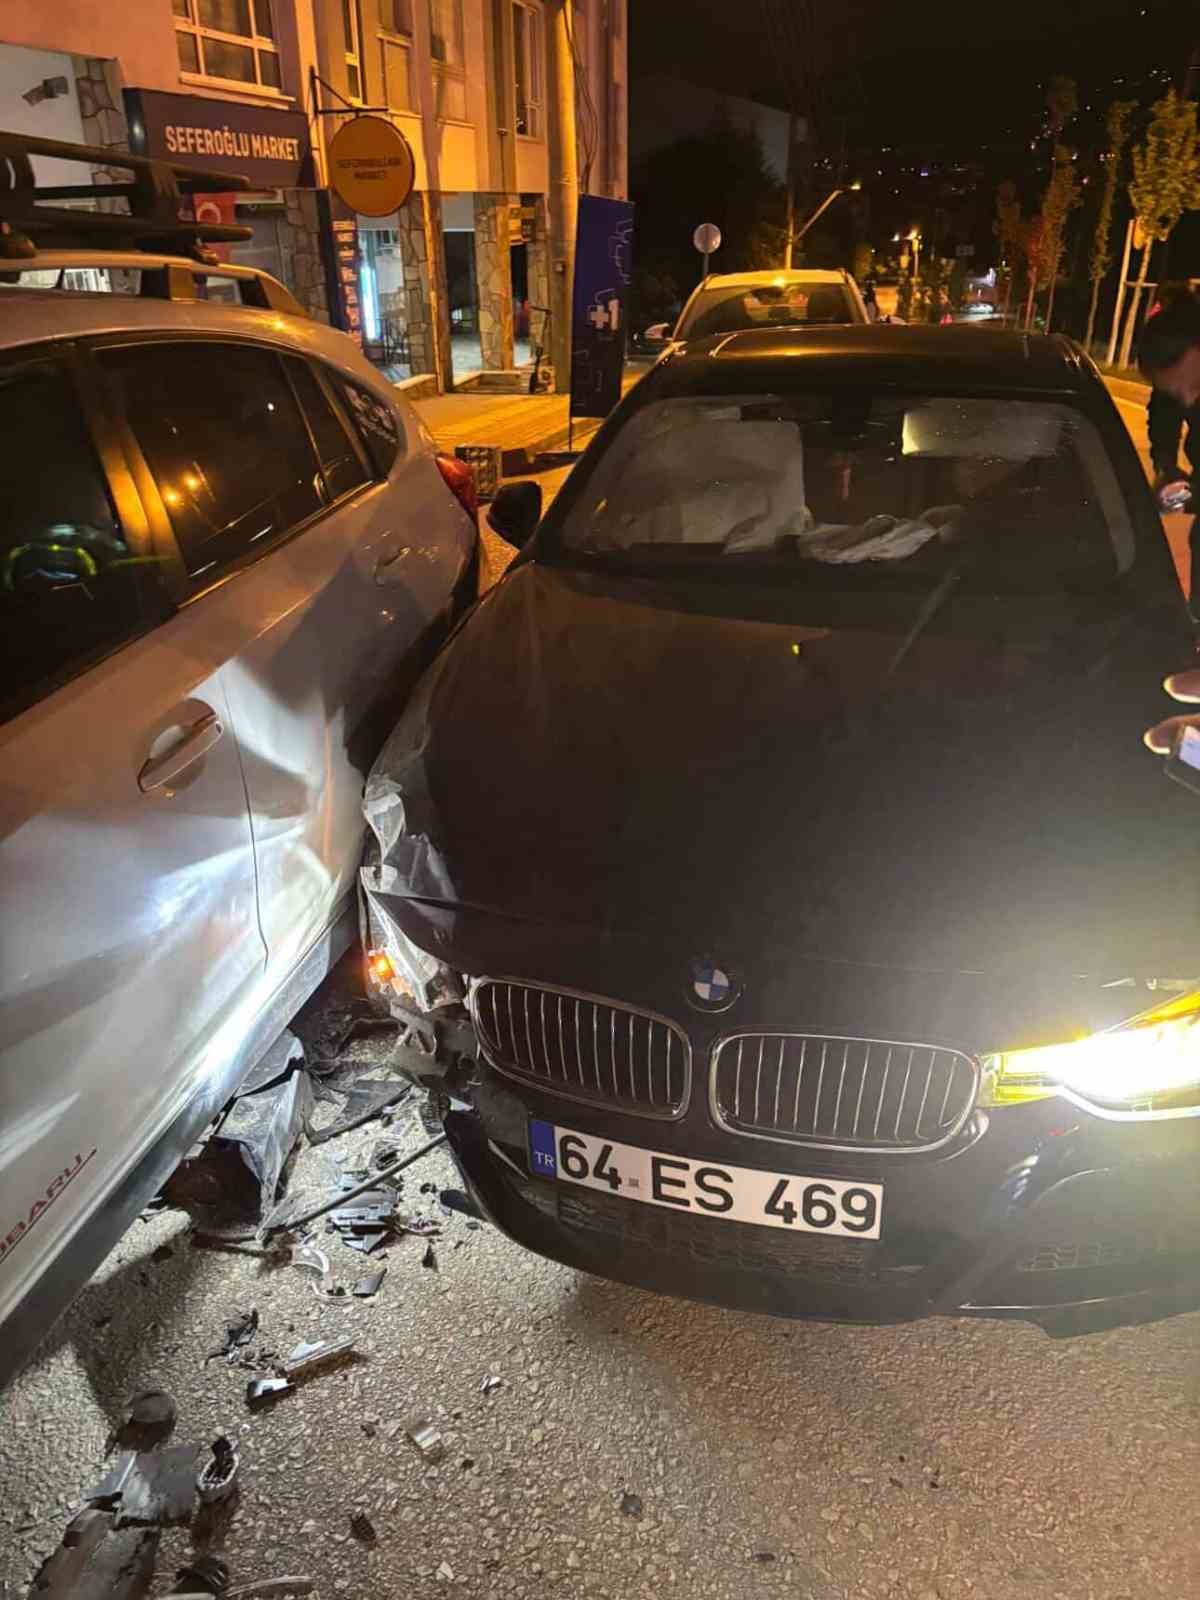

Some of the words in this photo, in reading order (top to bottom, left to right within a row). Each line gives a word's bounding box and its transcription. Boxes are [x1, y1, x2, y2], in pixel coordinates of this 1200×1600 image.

[165, 125, 250, 157] SEFEROĞLU
[251, 134, 299, 161] MARKET
[535, 1151, 554, 1169] TR
[559, 1134, 622, 1191] 64
[651, 1156, 734, 1213] ES
[764, 1179, 876, 1233] 469
